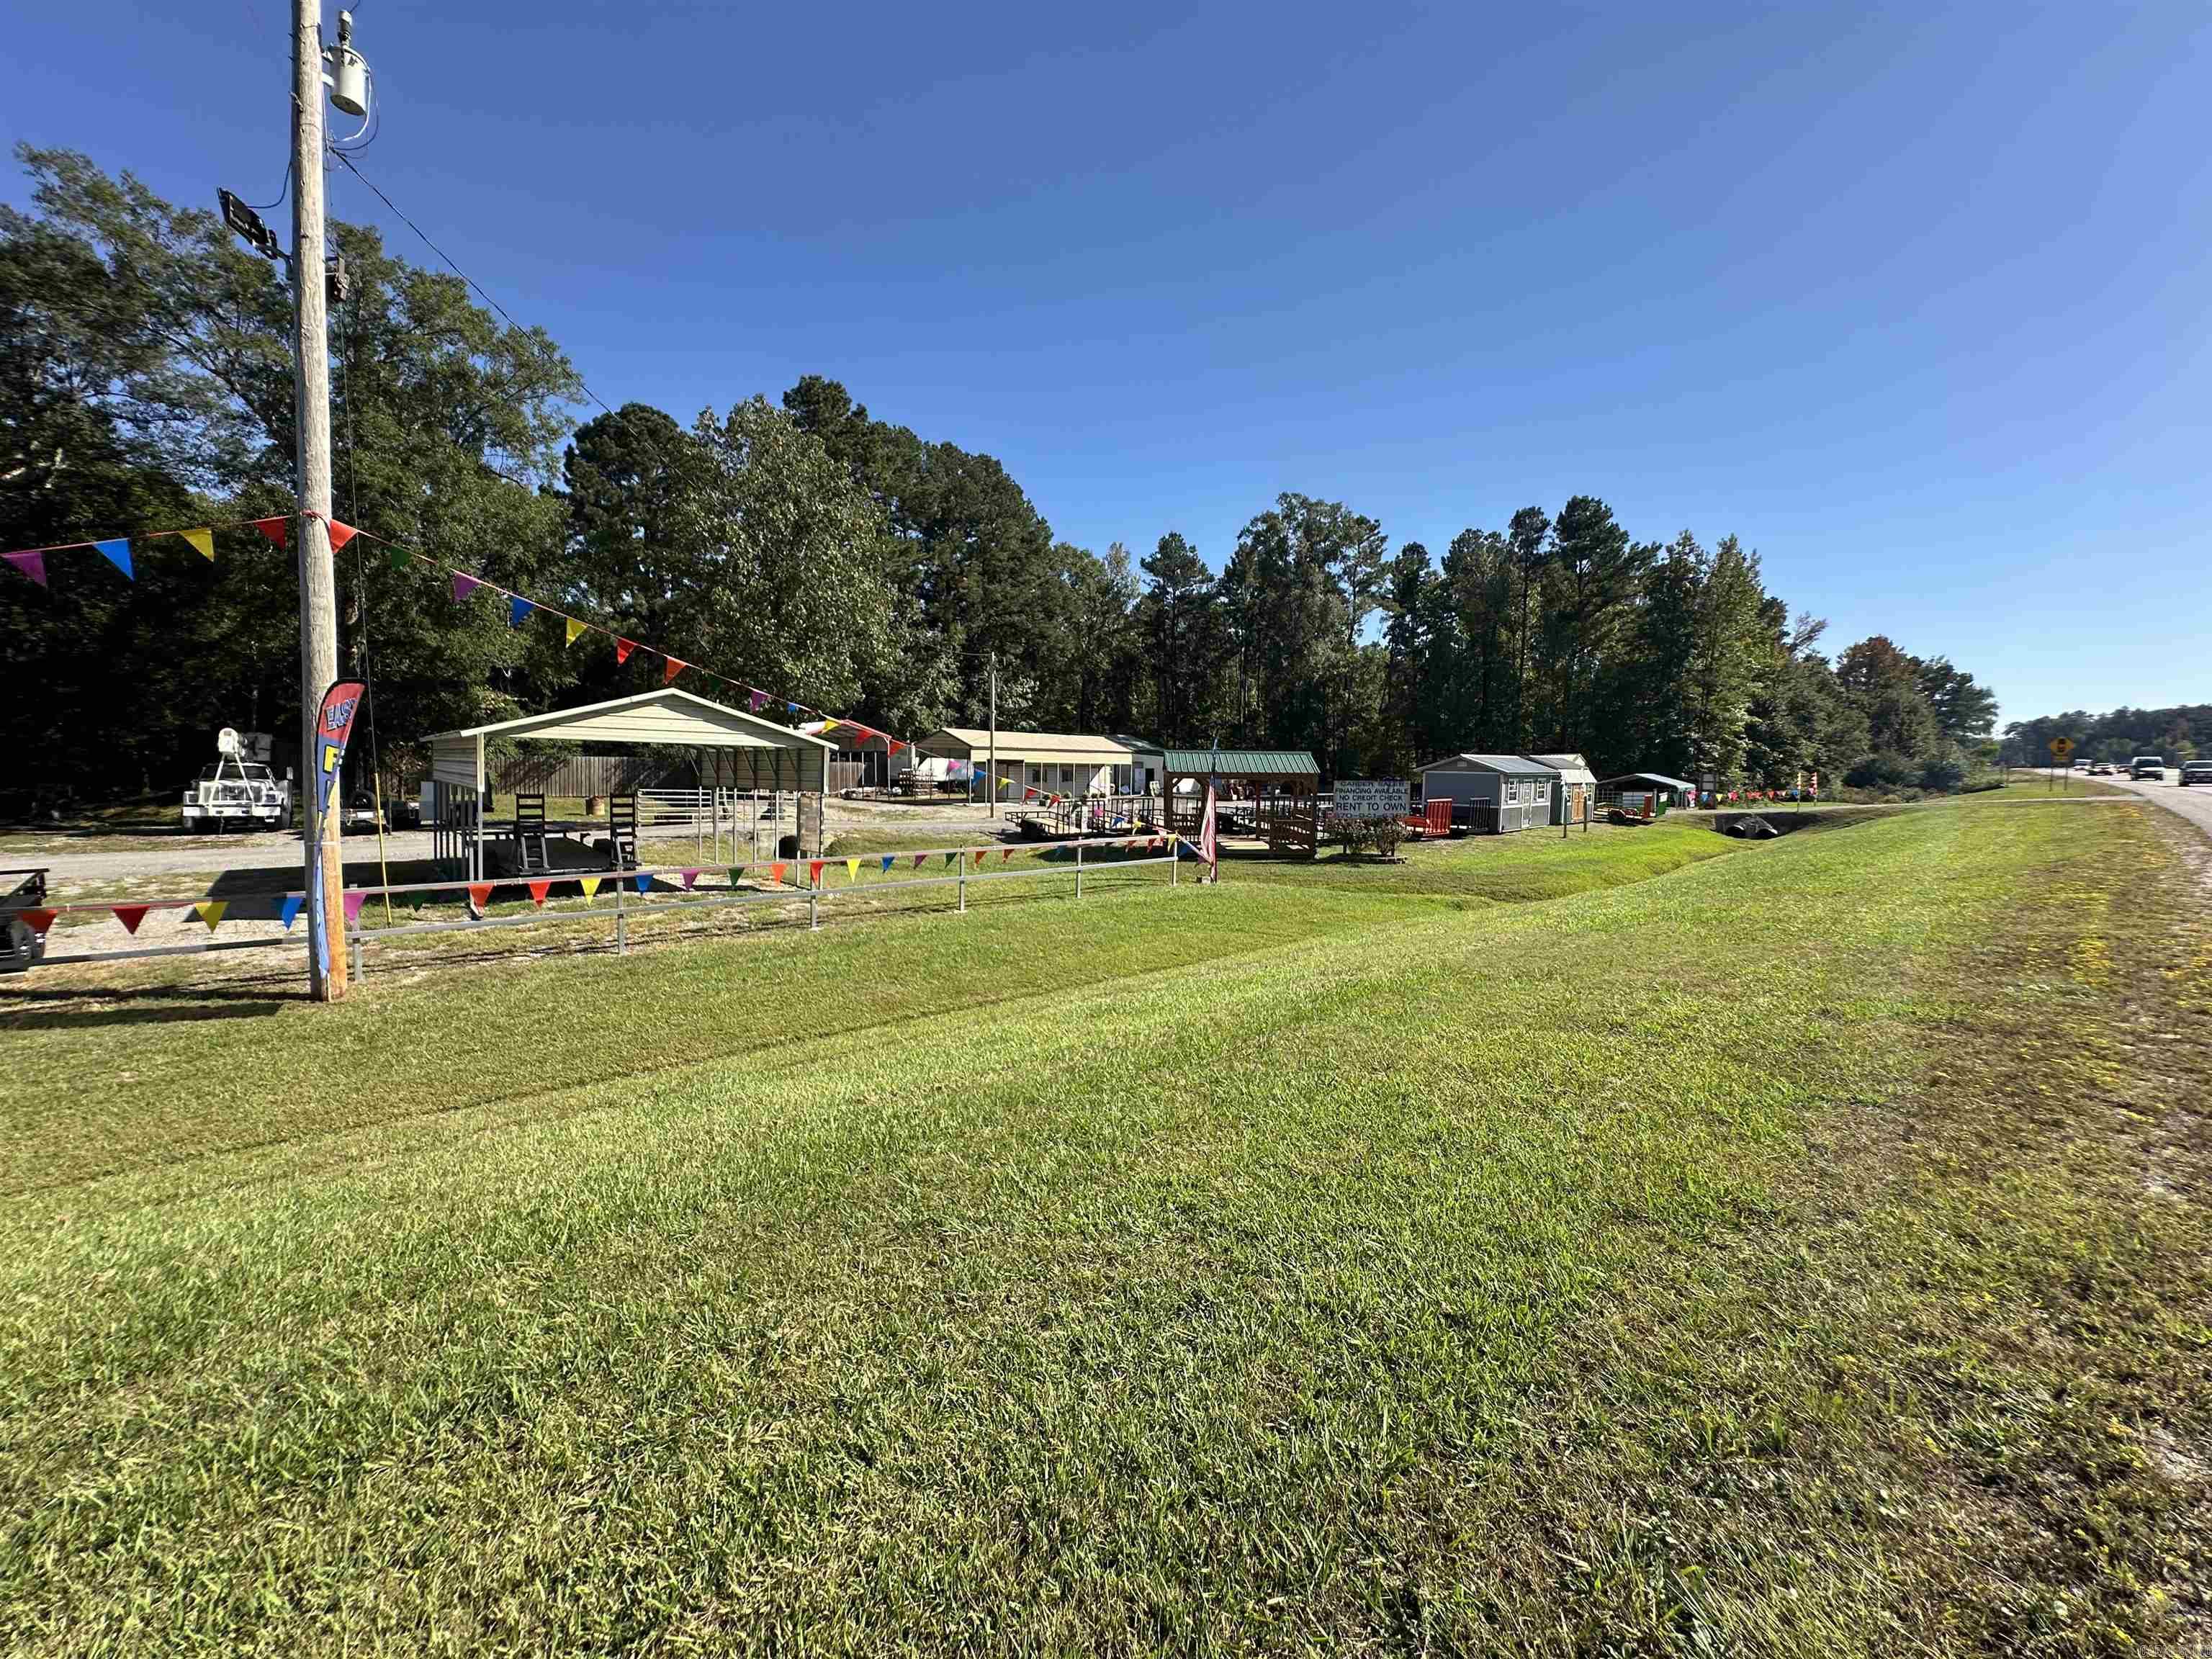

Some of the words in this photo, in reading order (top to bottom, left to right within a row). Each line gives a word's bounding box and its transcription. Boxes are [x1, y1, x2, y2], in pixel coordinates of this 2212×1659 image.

[1336, 802, 1362, 811] RENT
[1366, 802, 1380, 811] TO
[1383, 802, 1406, 811] OWN
